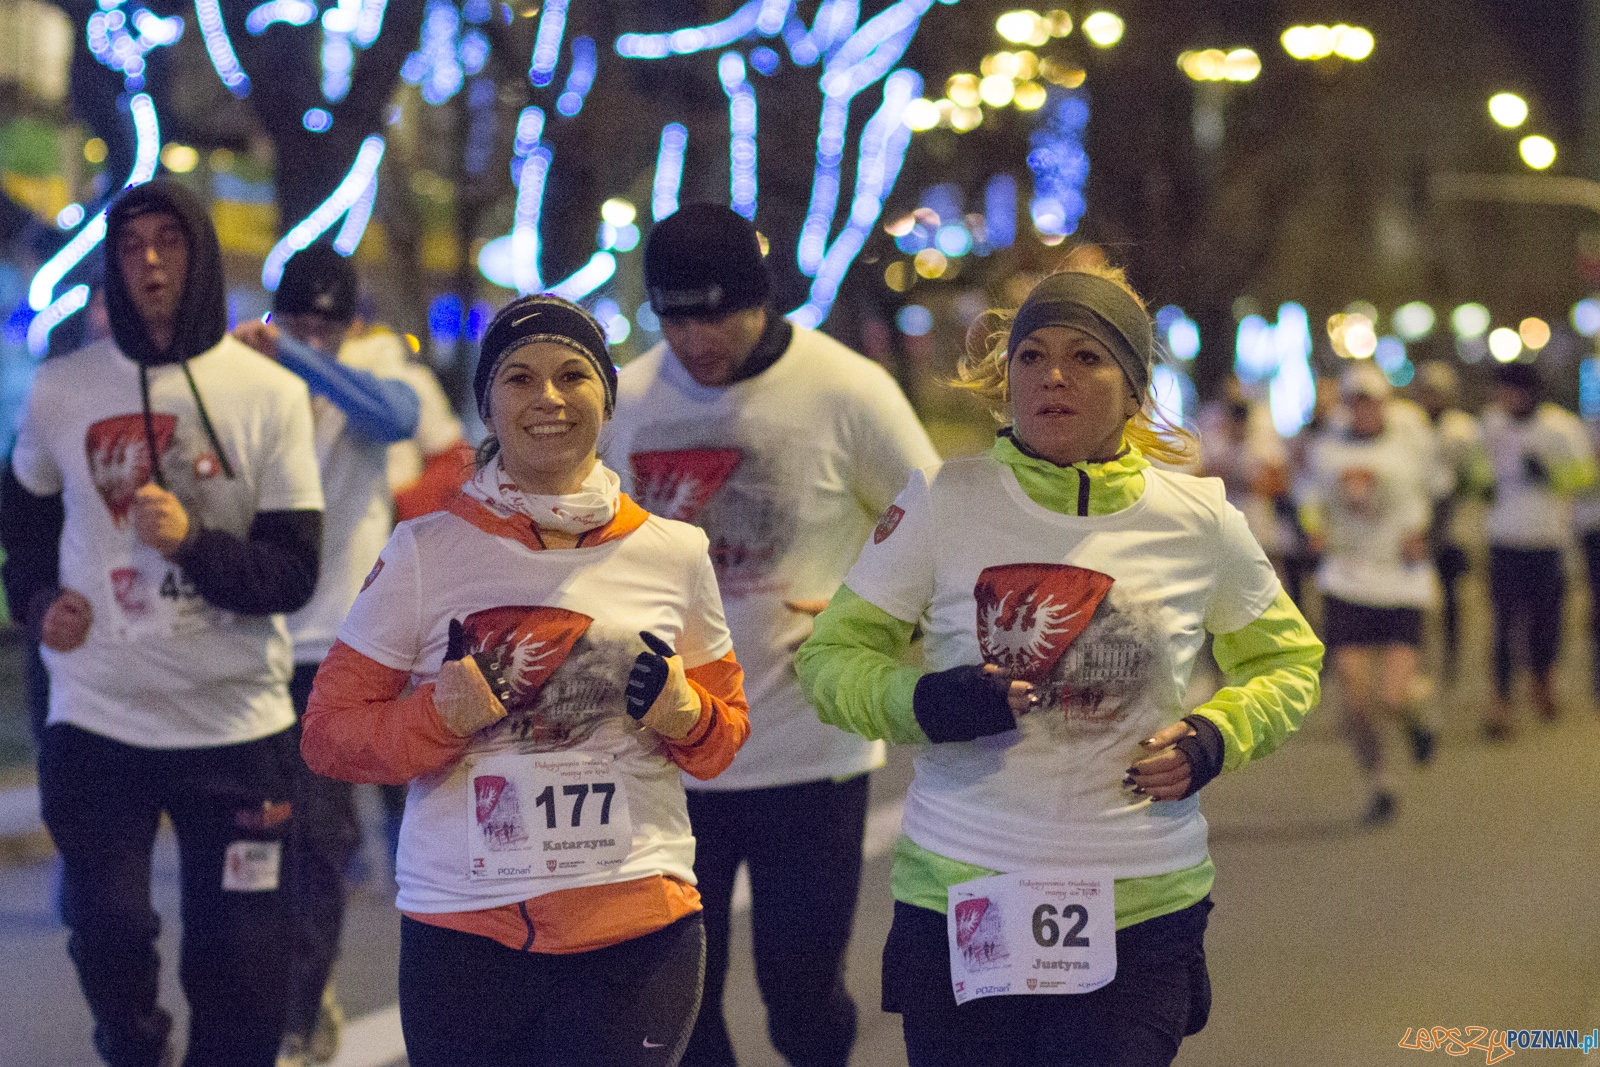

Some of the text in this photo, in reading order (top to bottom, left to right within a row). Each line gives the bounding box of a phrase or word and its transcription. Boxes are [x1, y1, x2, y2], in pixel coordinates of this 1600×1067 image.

[535, 783, 616, 829] 177
[543, 839, 616, 851] Katarzyna
[1032, 904, 1090, 948] 62
[1032, 959, 1090, 971] Justyna
